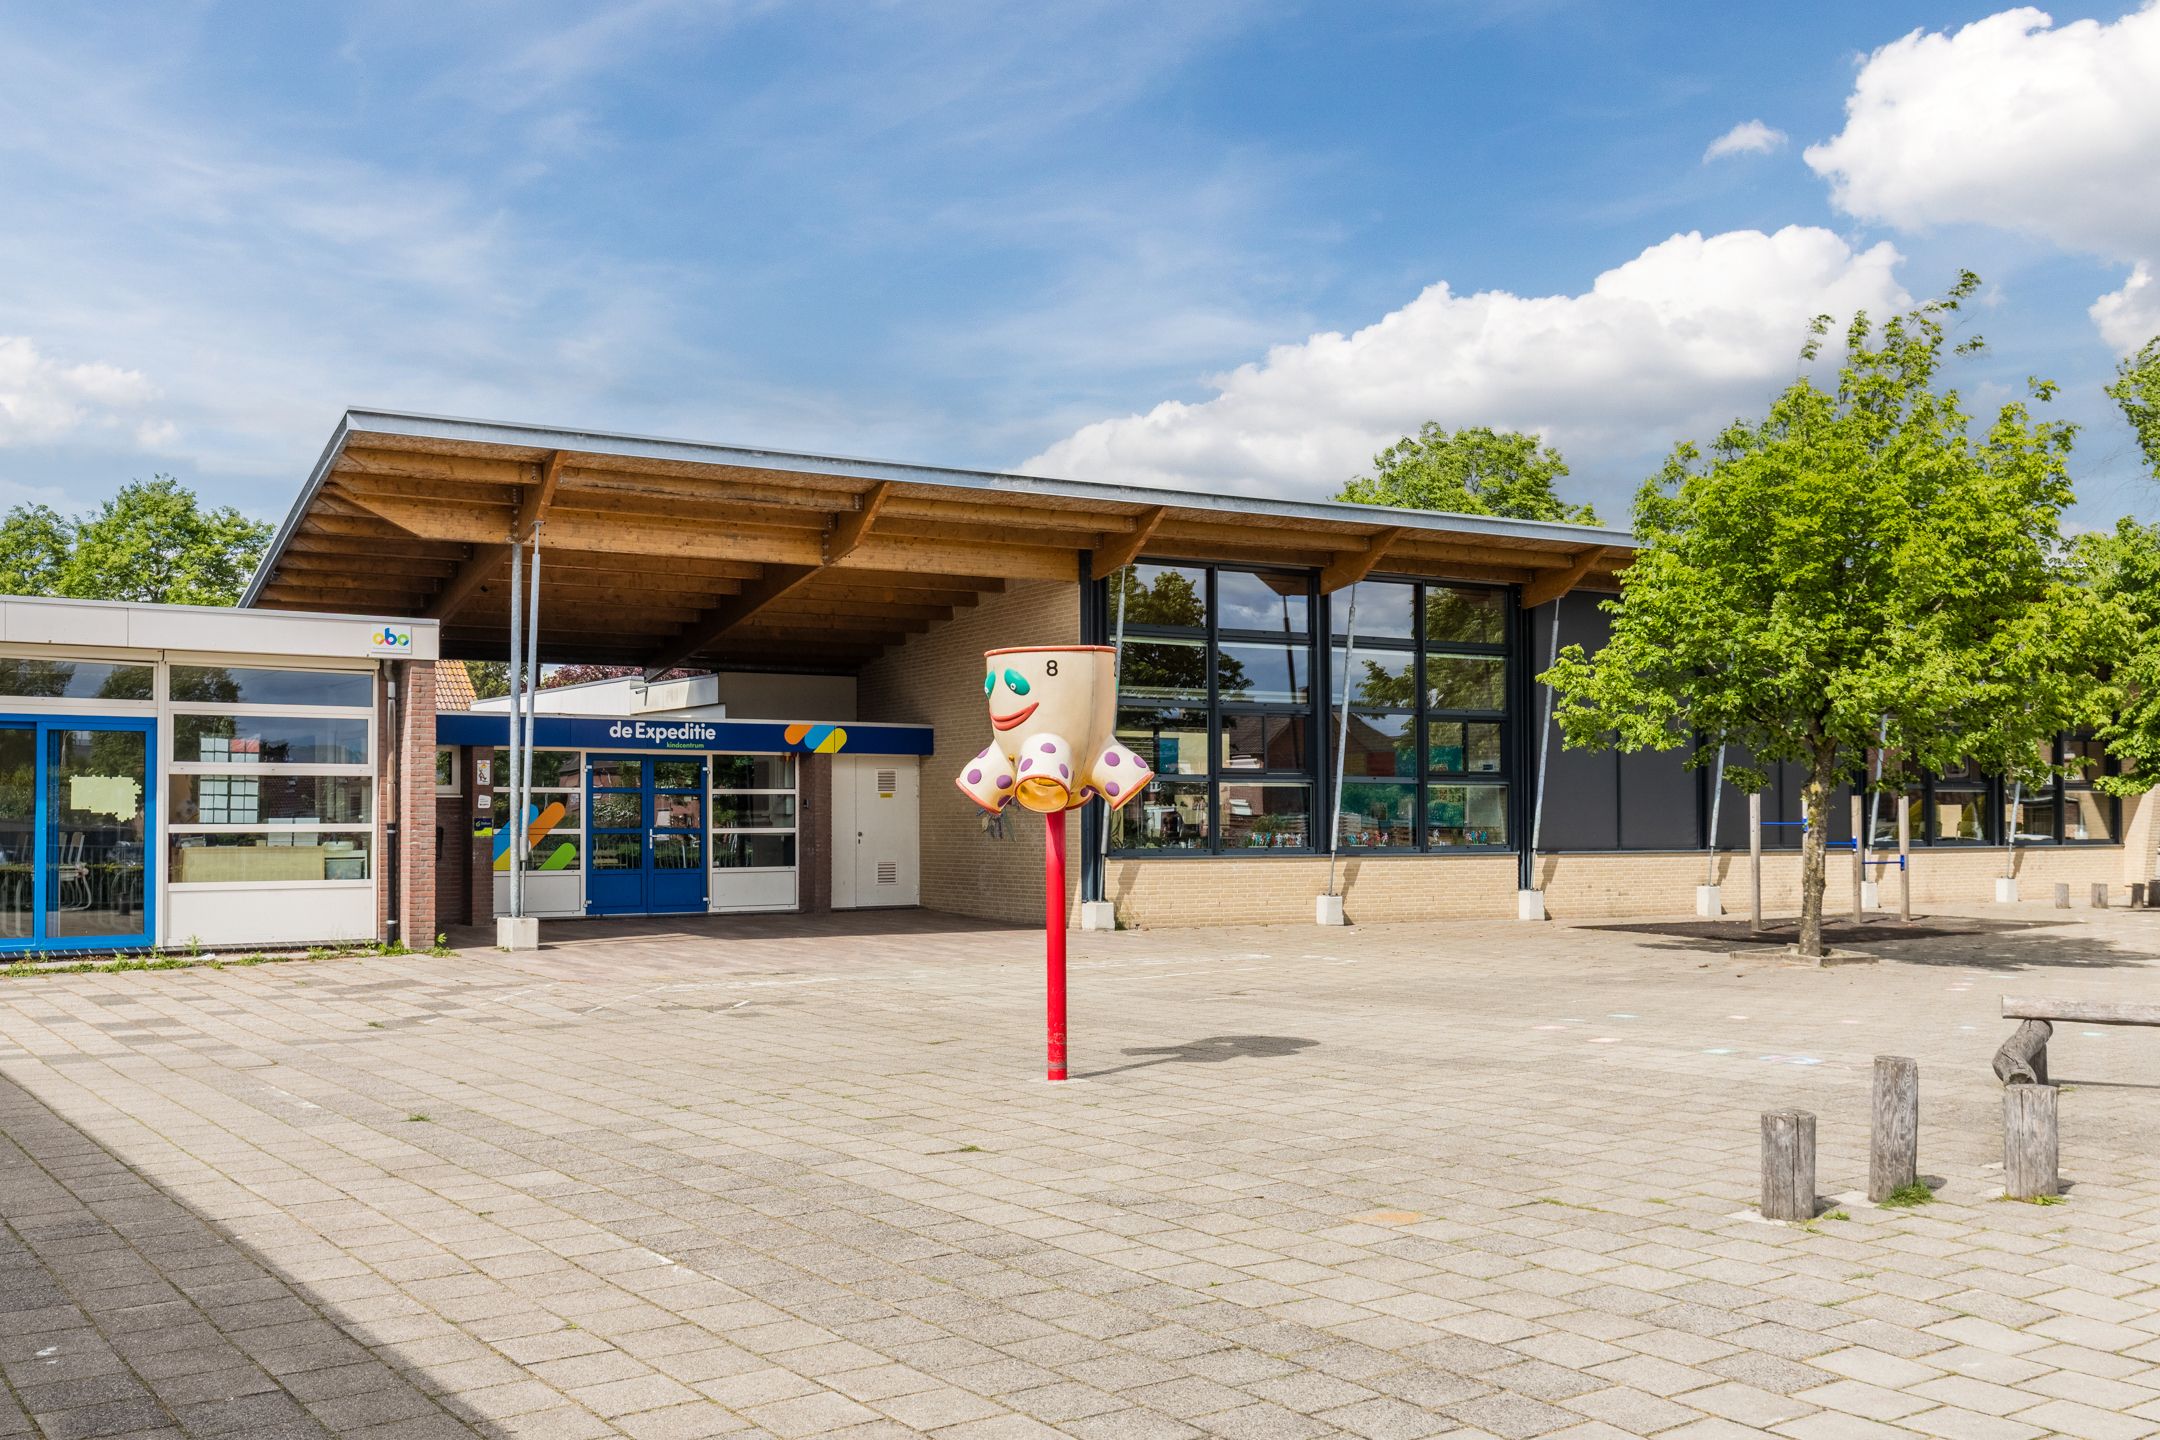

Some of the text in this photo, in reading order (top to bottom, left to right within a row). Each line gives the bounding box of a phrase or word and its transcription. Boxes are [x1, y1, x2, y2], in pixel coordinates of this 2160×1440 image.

[1046, 660, 1058, 676] 8
[609, 721, 717, 744] de Expeditie
